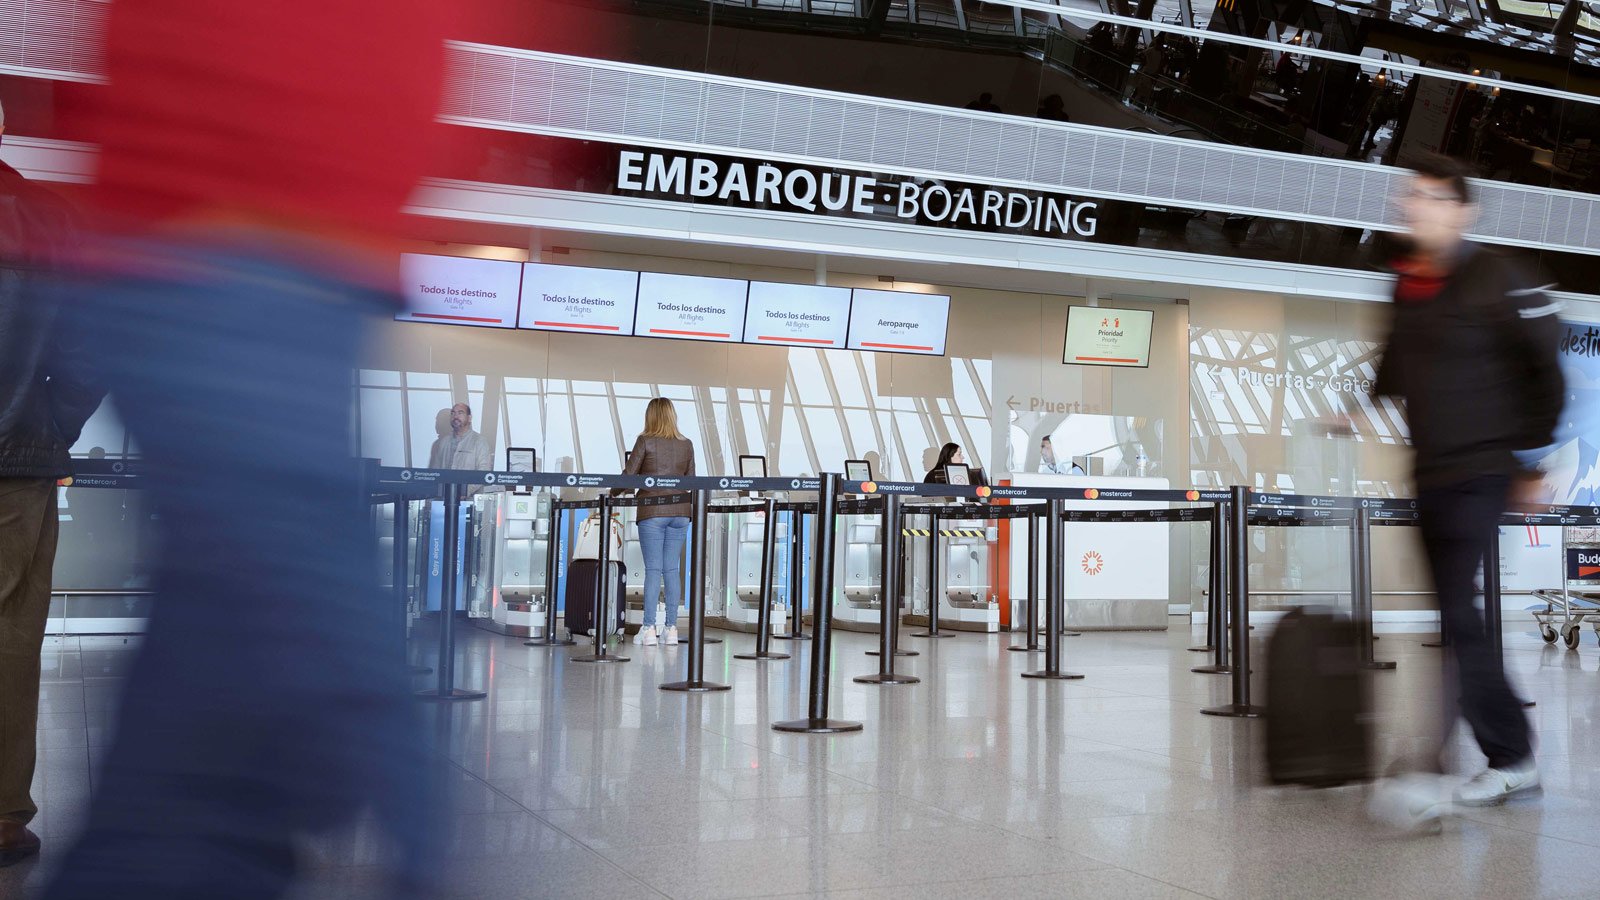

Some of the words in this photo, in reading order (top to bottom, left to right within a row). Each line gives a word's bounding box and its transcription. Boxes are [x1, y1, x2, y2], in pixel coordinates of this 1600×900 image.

[618, 150, 876, 214] EMBARQUE
[898, 182, 1098, 236] BOARDING
[420, 285, 445, 294] Todos
[447, 287, 459, 295] los
[461, 288, 497, 298] destinos
[542, 294, 566, 303] Todos
[568, 296, 579, 304] los
[581, 297, 615, 306] destinos
[658, 303, 680, 311] Todos
[694, 305, 726, 314] destinos
[800, 313, 830, 322] destinos
[878, 319, 919, 329] Aeroparque
[1560, 326, 1600, 358] desti
[1238, 367, 1314, 390] Puertas
[1578, 553, 1600, 566] Bud
